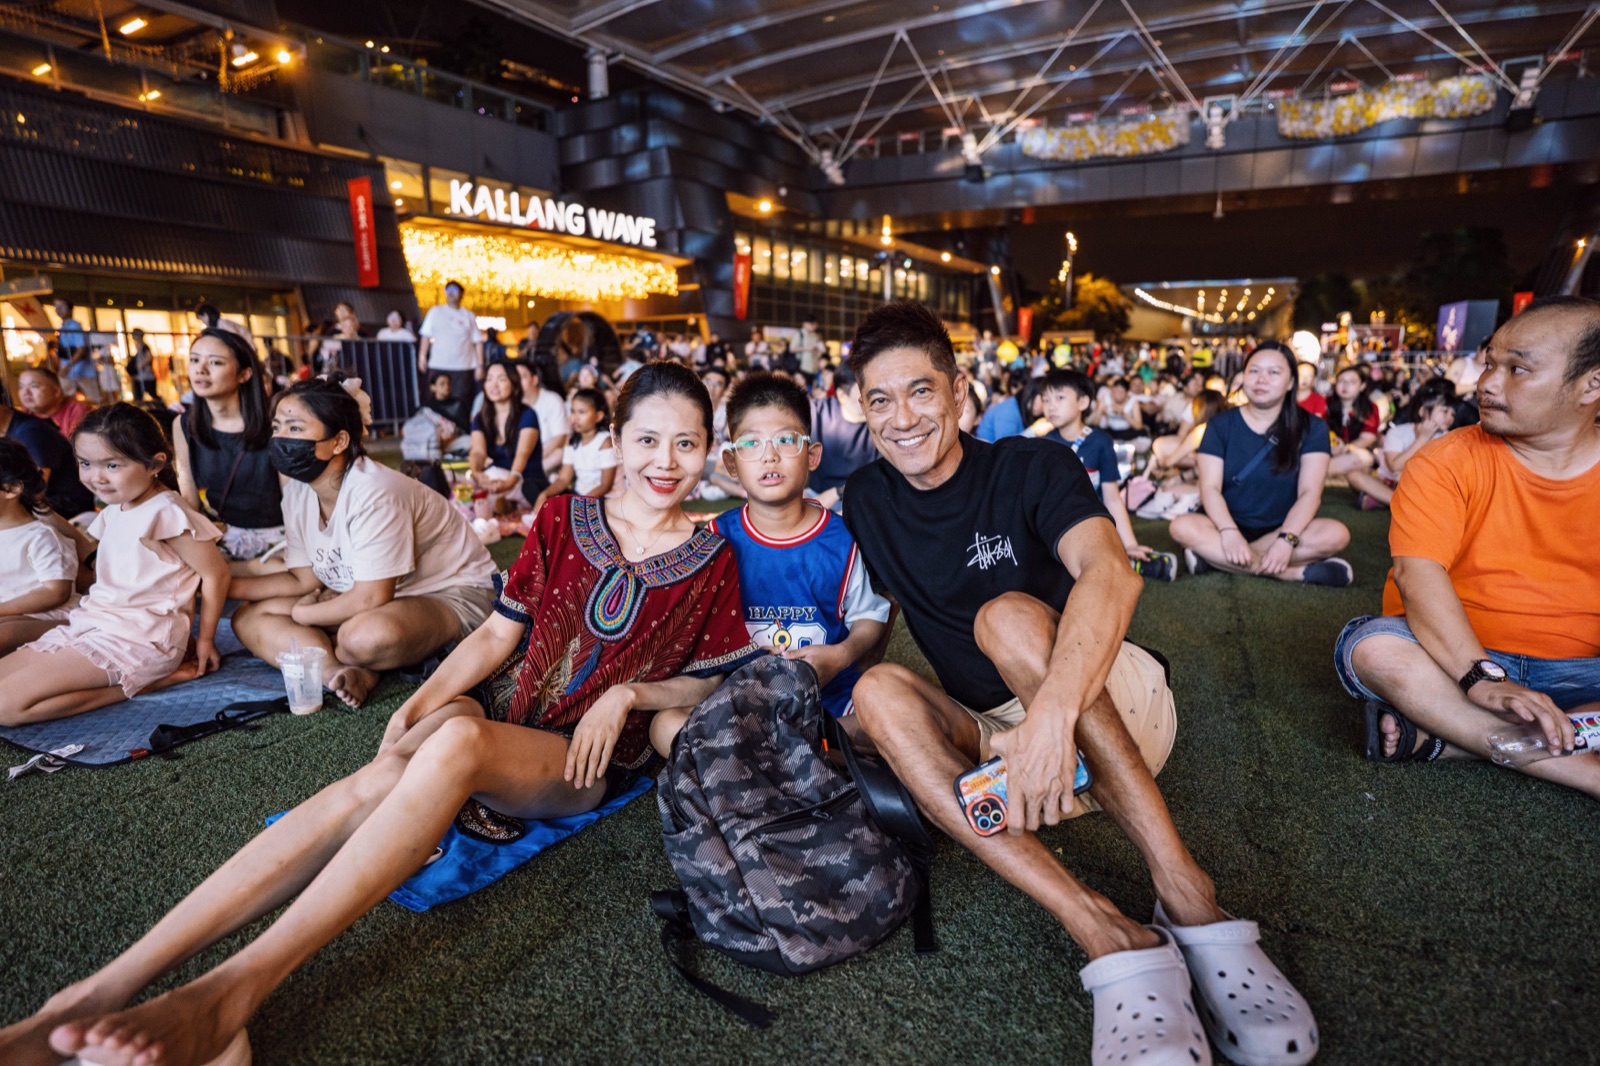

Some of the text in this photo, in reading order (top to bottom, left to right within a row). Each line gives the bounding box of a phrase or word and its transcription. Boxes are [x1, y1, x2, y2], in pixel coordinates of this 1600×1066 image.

[450, 179, 657, 248] KALLANG WAVE
[749, 606, 817, 621] HAPPY
